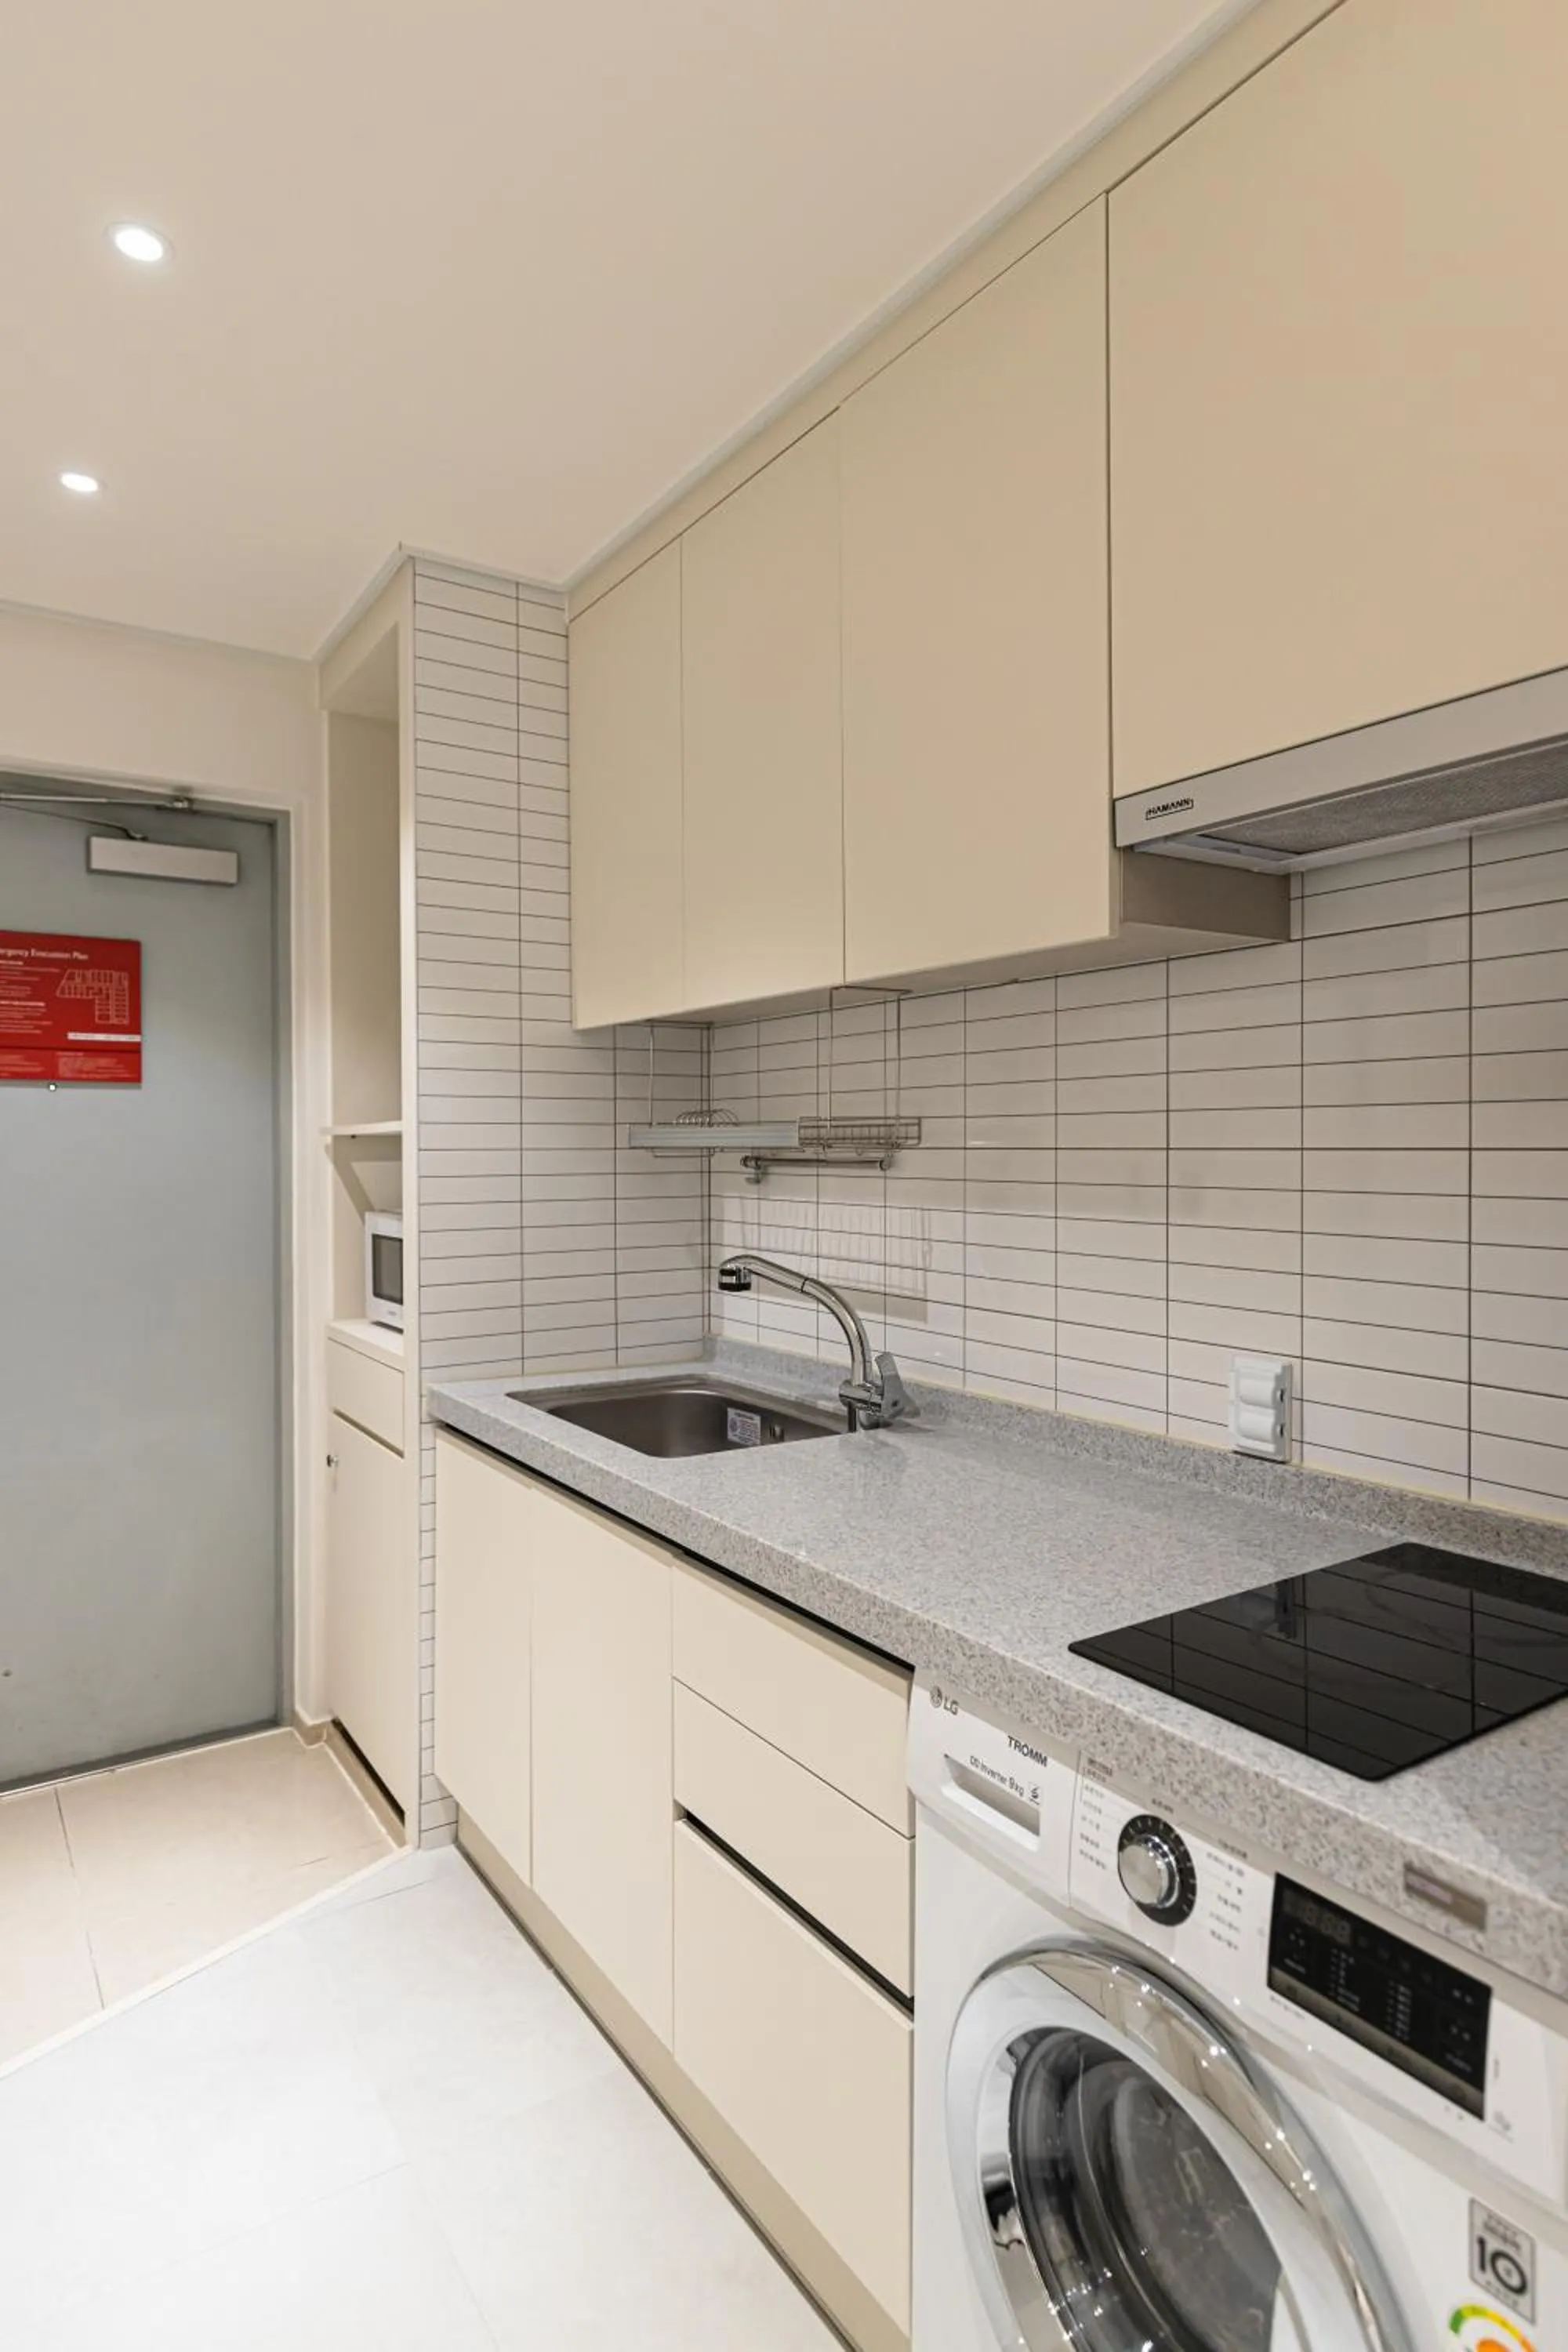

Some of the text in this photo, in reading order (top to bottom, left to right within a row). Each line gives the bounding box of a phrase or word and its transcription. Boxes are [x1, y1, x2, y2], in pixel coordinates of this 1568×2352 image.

[1147, 798, 1190, 815] HAMANN
[943, 1694, 960, 1715] LG
[1007, 1735, 1047, 1767] TROMM
[1477, 2236, 1528, 2296] 10
